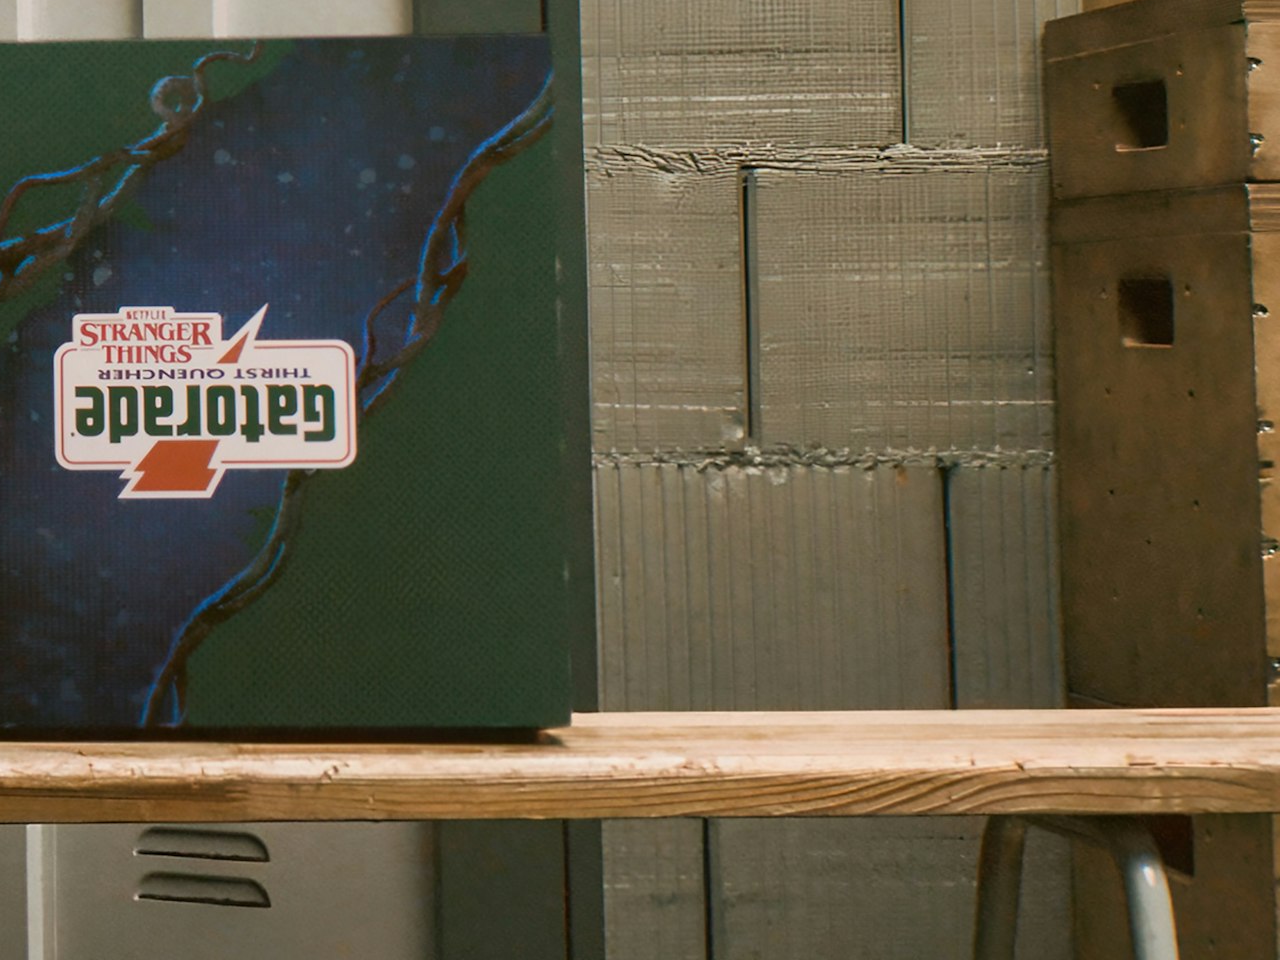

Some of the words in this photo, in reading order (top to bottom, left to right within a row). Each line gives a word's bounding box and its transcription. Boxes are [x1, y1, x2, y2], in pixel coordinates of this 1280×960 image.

[80, 322, 213, 347] STRANGER
[102, 345, 193, 364] THINGS
[98, 368, 226, 380] QUENCHER
[233, 367, 312, 379] THIRST
[75, 384, 336, 444] Gatorade
